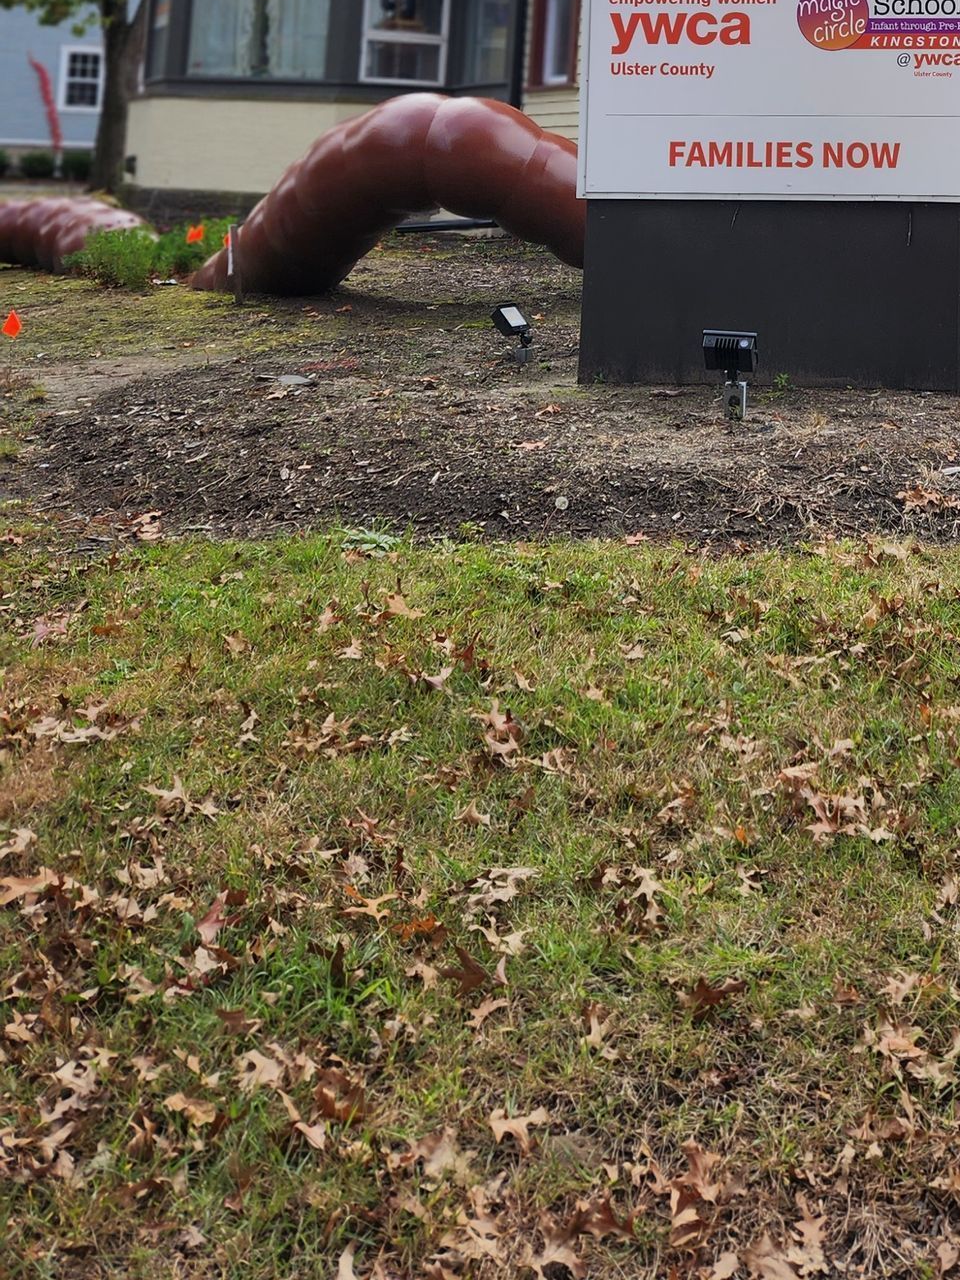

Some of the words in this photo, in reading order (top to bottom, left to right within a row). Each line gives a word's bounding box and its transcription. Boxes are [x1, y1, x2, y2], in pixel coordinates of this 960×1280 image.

[609, 12, 752, 55] ywca
[813, 9, 866, 43] circle
[870, 21, 899, 31] Infant
[900, 21, 937, 32] through
[610, 61, 657, 76] Ulster
[660, 62, 715, 79] County
[932, 71, 953, 79] County
[668, 141, 814, 169] FAMILIES
[822, 142, 902, 169] NOW
